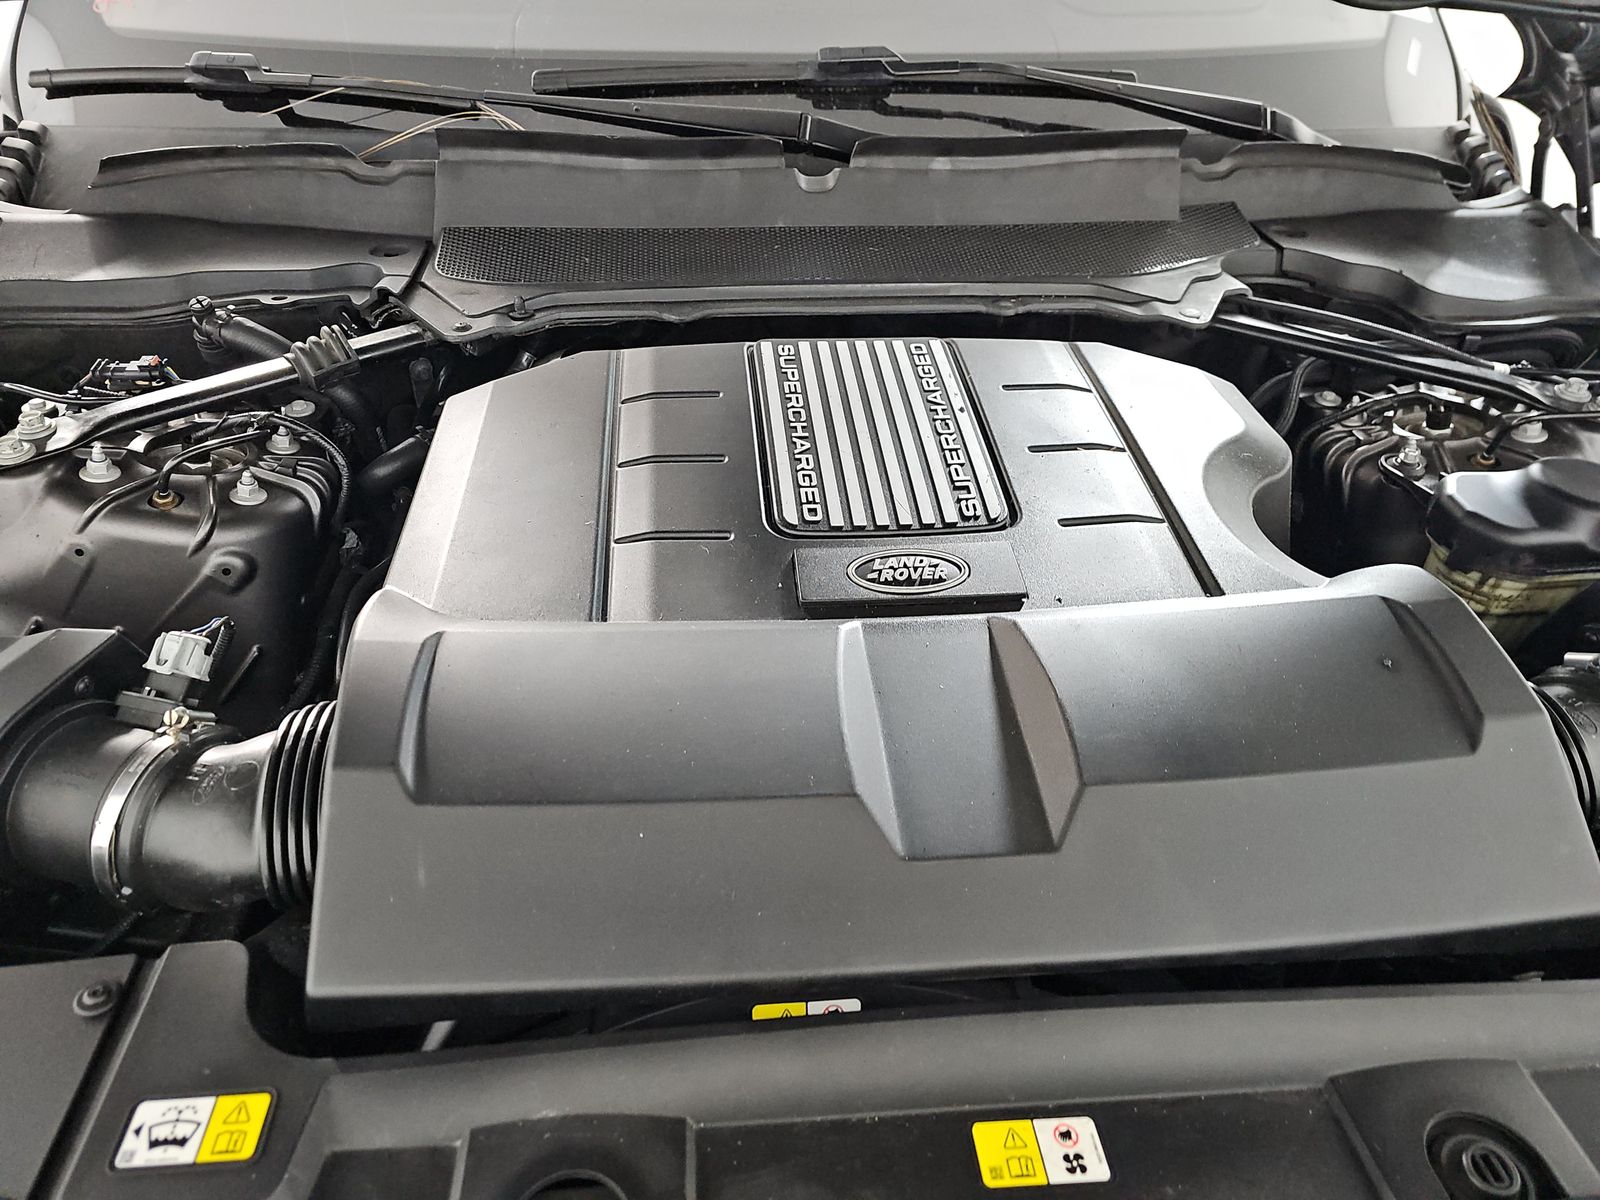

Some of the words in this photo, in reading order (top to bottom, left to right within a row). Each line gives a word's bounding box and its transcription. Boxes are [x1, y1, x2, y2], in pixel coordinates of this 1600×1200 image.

[777, 343, 822, 522] SUPERCHARGED
[909, 343, 982, 518] SUPERCHARGED
[873, 556, 928, 569] LAND
[880, 567, 948, 582] ROVER
